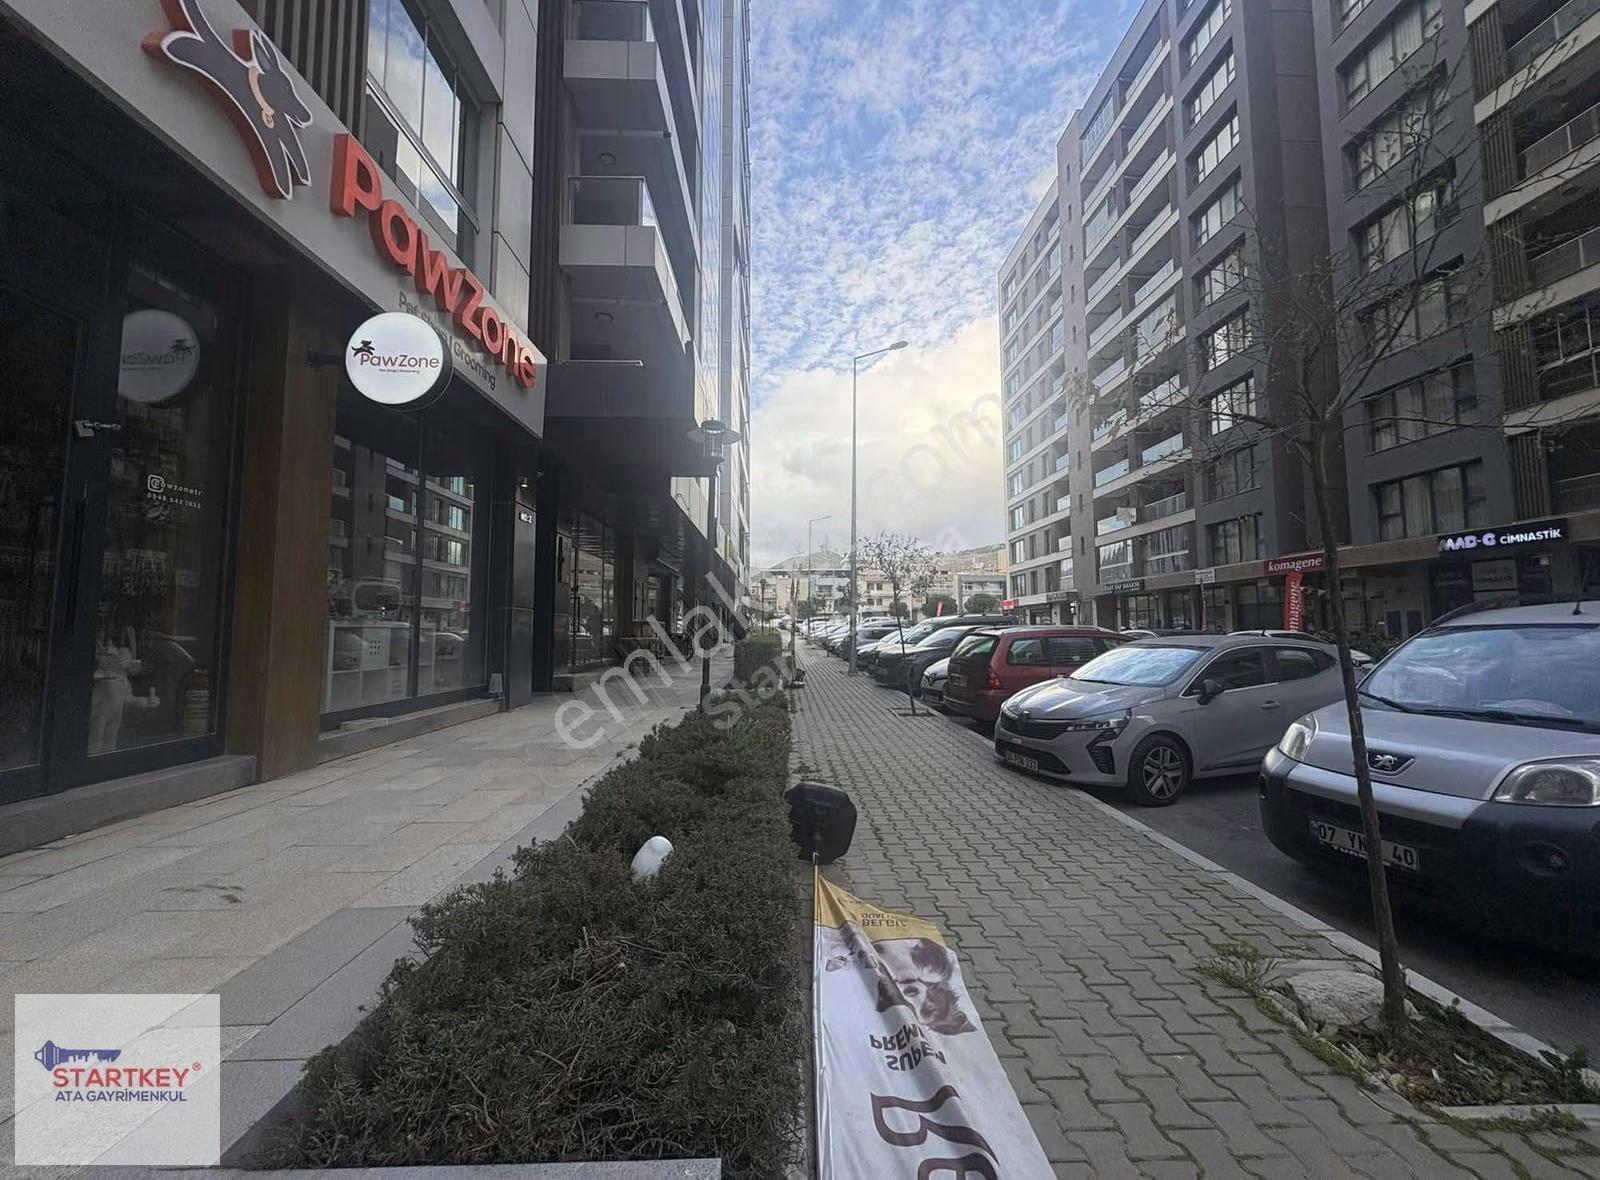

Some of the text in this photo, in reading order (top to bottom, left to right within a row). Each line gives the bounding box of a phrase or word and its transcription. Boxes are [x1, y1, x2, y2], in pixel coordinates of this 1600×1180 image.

[360, 353, 440, 369] PawZone
[454, 341, 496, 390] Grooming
[1499, 527, 1563, 545] CİMNASTİK
[1268, 557, 1322, 571] komagene
[1319, 824, 1336, 842] 07
[1393, 846, 1414, 866] 40
